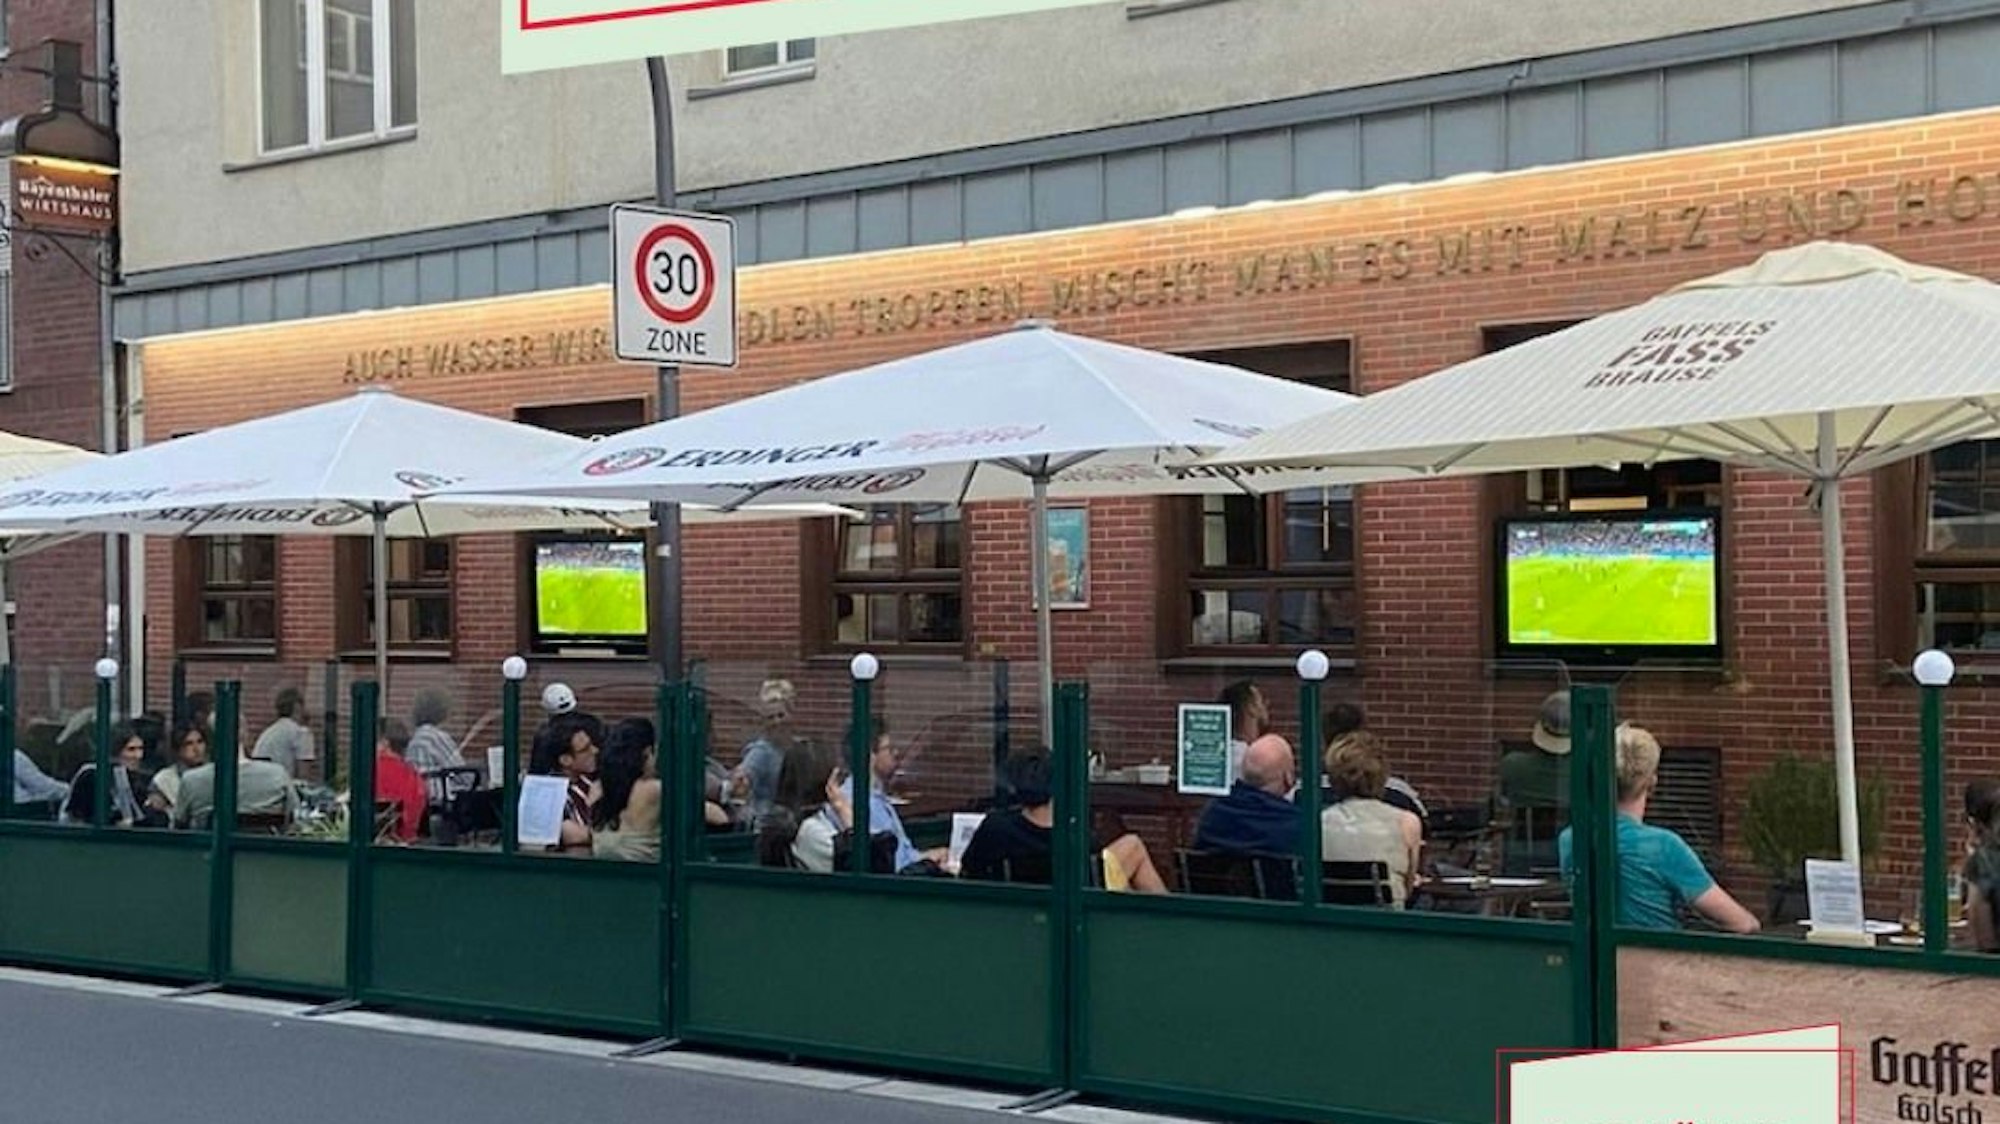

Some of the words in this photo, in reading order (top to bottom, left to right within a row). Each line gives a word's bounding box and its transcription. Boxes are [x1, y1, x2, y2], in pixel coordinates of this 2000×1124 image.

[19, 198, 113, 219] WIRTSHAUS
[343, 346, 413, 383] AUCH
[427, 335, 536, 376] WASSER
[550, 327, 611, 364] WIR
[746, 302, 836, 345] DLEN
[1052, 262, 1213, 316] MISCHT
[1235, 243, 1336, 296] MAN
[1360, 237, 1412, 283] ES
[1435, 222, 1530, 277] MIT
[1555, 205, 1708, 264] MALZ
[1737, 188, 1868, 243] UND
[1897, 173, 2000, 228] HO
[652, 251, 699, 296] 30
[646, 327, 707, 356] ZONE
[1641, 320, 1778, 342] GAFFELS
[1606, 338, 1757, 368] FASS
[1584, 364, 1724, 389] BRAUSE
[656, 441, 878, 468] ERDINGER
[1871, 1036, 2000, 1096] Gaffel
